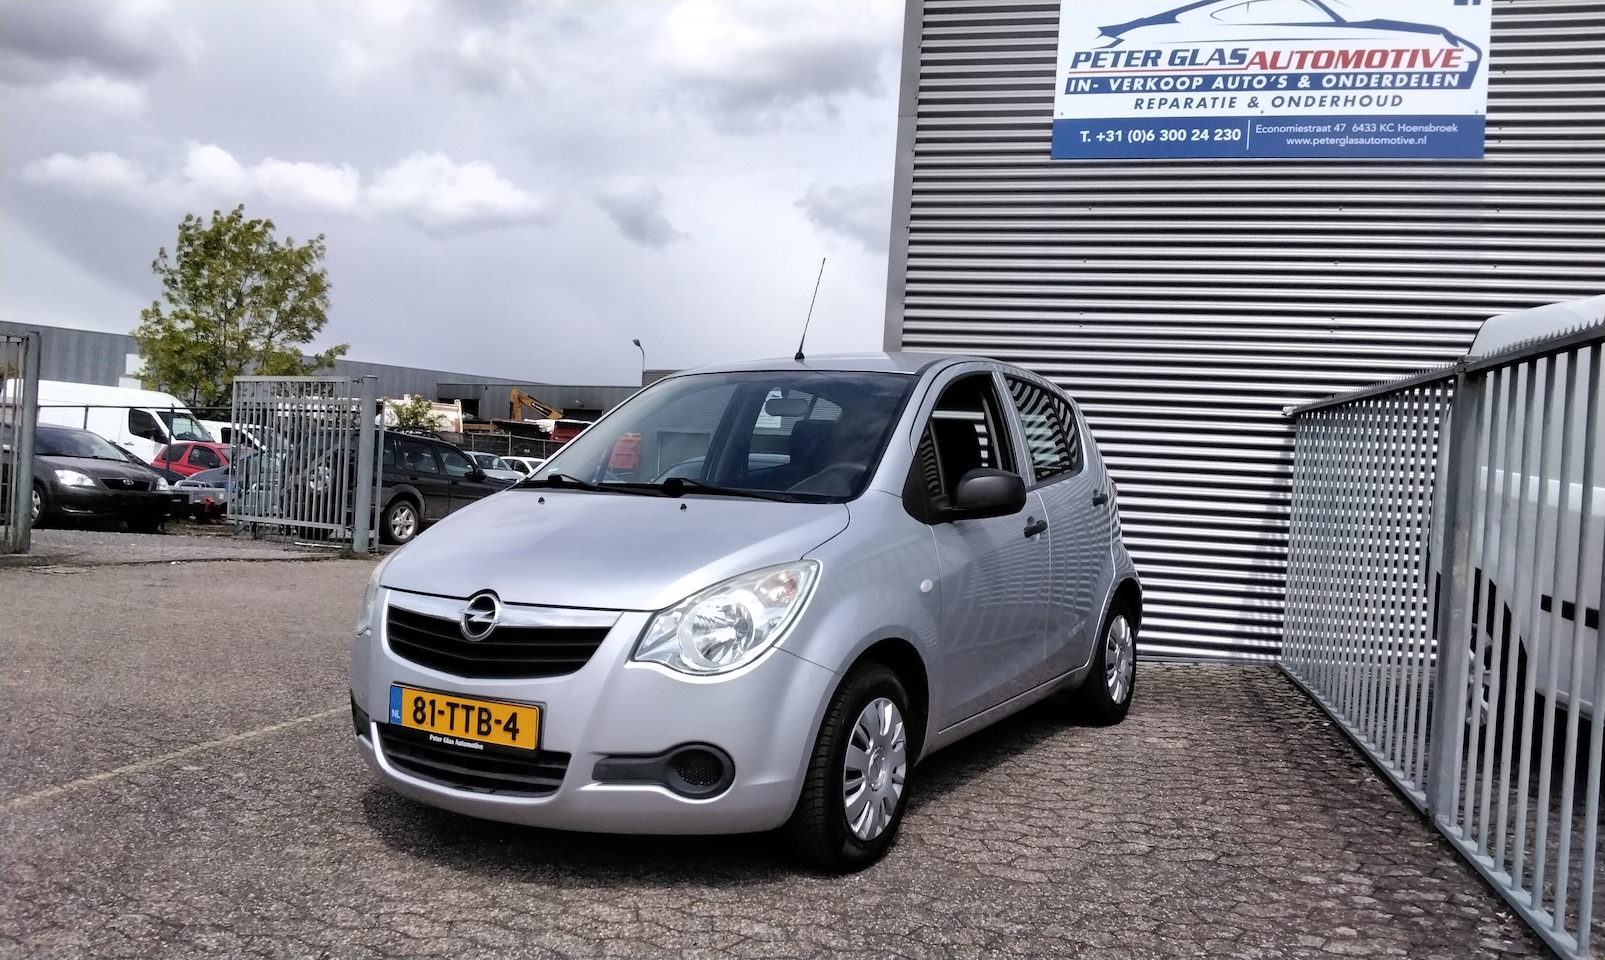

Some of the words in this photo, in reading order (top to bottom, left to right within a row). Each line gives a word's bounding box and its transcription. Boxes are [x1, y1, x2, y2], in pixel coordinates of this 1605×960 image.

[1070, 49, 1163, 69] PETER
[1246, 48, 1465, 71] AUTOMOTIVE
[1069, 78, 1099, 92] IN-
[1109, 76, 1204, 91] VERKOOP
[1211, 75, 1289, 90] AUTO'S
[1297, 74, 1311, 89] &
[1321, 73, 1460, 88] ONDERDELEN
[1133, 96, 1238, 110] REPARATIE
[1247, 96, 1260, 109] &
[1270, 94, 1404, 108] ONDERHOUD
[1080, 130, 1092, 143] T.
[1096, 129, 1123, 142] +31
[1127, 129, 1156, 144] (0)6
[1159, 128, 1187, 142] 300
[1190, 128, 1210, 142] 24
[1213, 128, 1242, 141] 230
[1255, 123, 1332, 134] Economiestraat
[1333, 123, 1346, 133] 47
[1351, 123, 1377, 133] 6433
[1379, 123, 1395, 133] KC
[1397, 122, 1459, 133] Hoensbroek
[1286, 135, 1428, 147] www.peterglasautomotive.nl
[391, 708, 401, 719] NL
[412, 696, 520, 741] 81-TTB-4
[429, 734, 442, 743] Peter
[442, 736, 455, 746] Glas
[454, 739, 484, 750] Automotive
